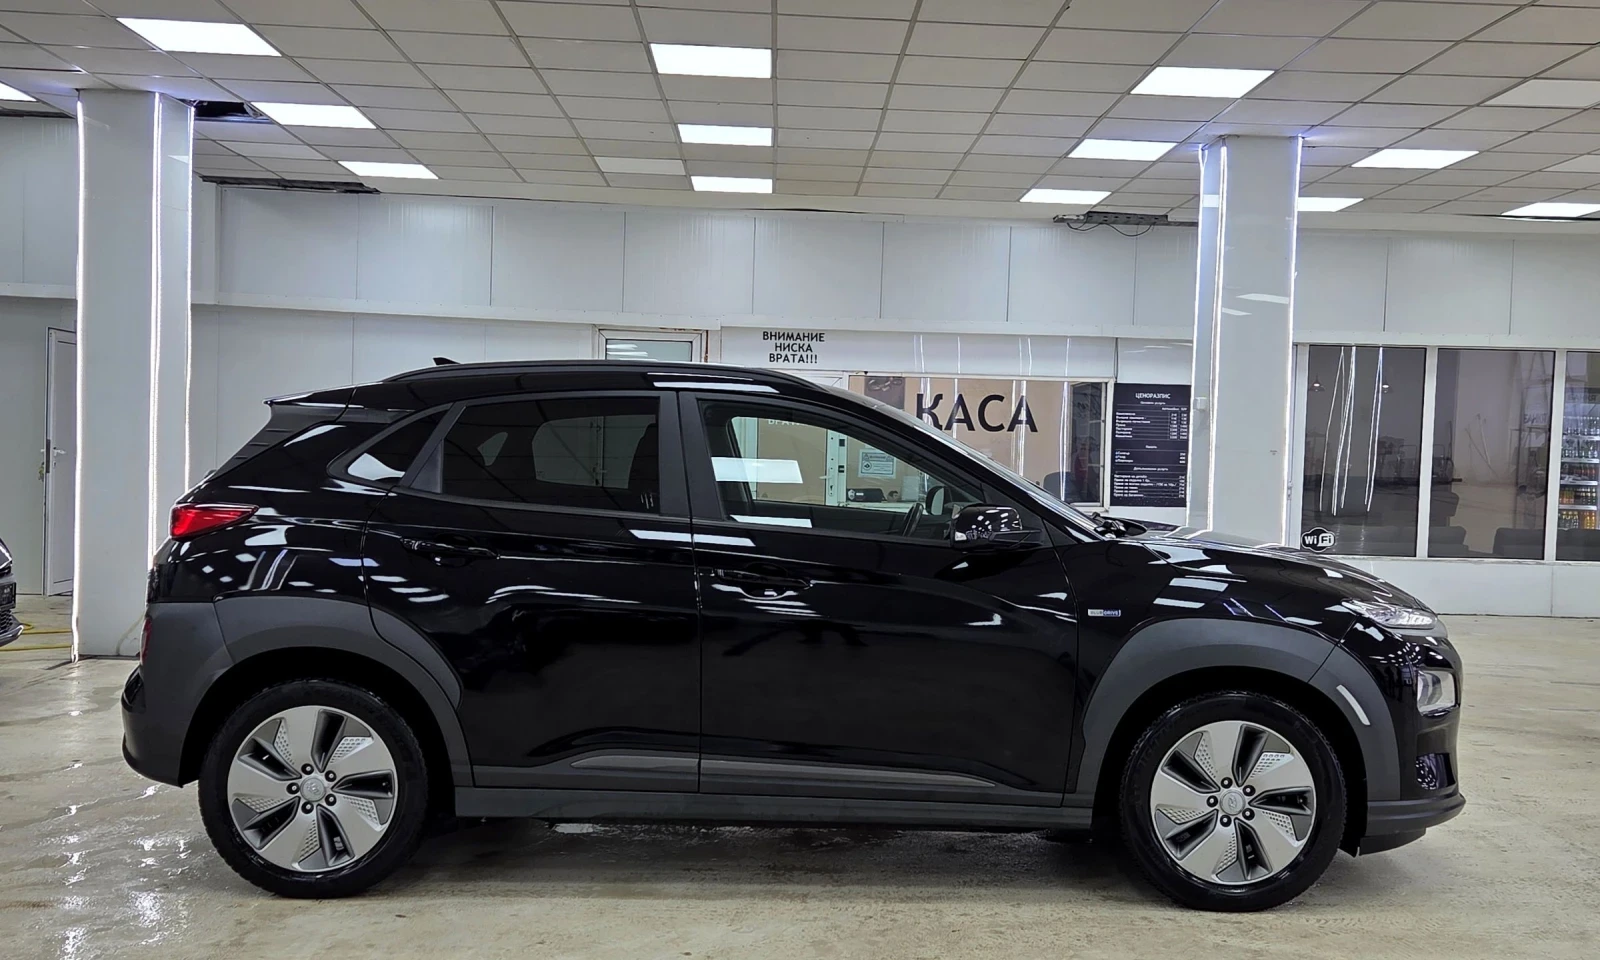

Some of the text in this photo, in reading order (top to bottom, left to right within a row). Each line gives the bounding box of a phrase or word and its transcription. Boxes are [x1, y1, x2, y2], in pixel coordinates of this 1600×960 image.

[762, 331, 825, 342] ВНИМАНИЕ
[775, 342, 813, 352] НИСКА
[769, 353, 818, 364] ВРАТА!!!
[916, 393, 1038, 432] КАСА
